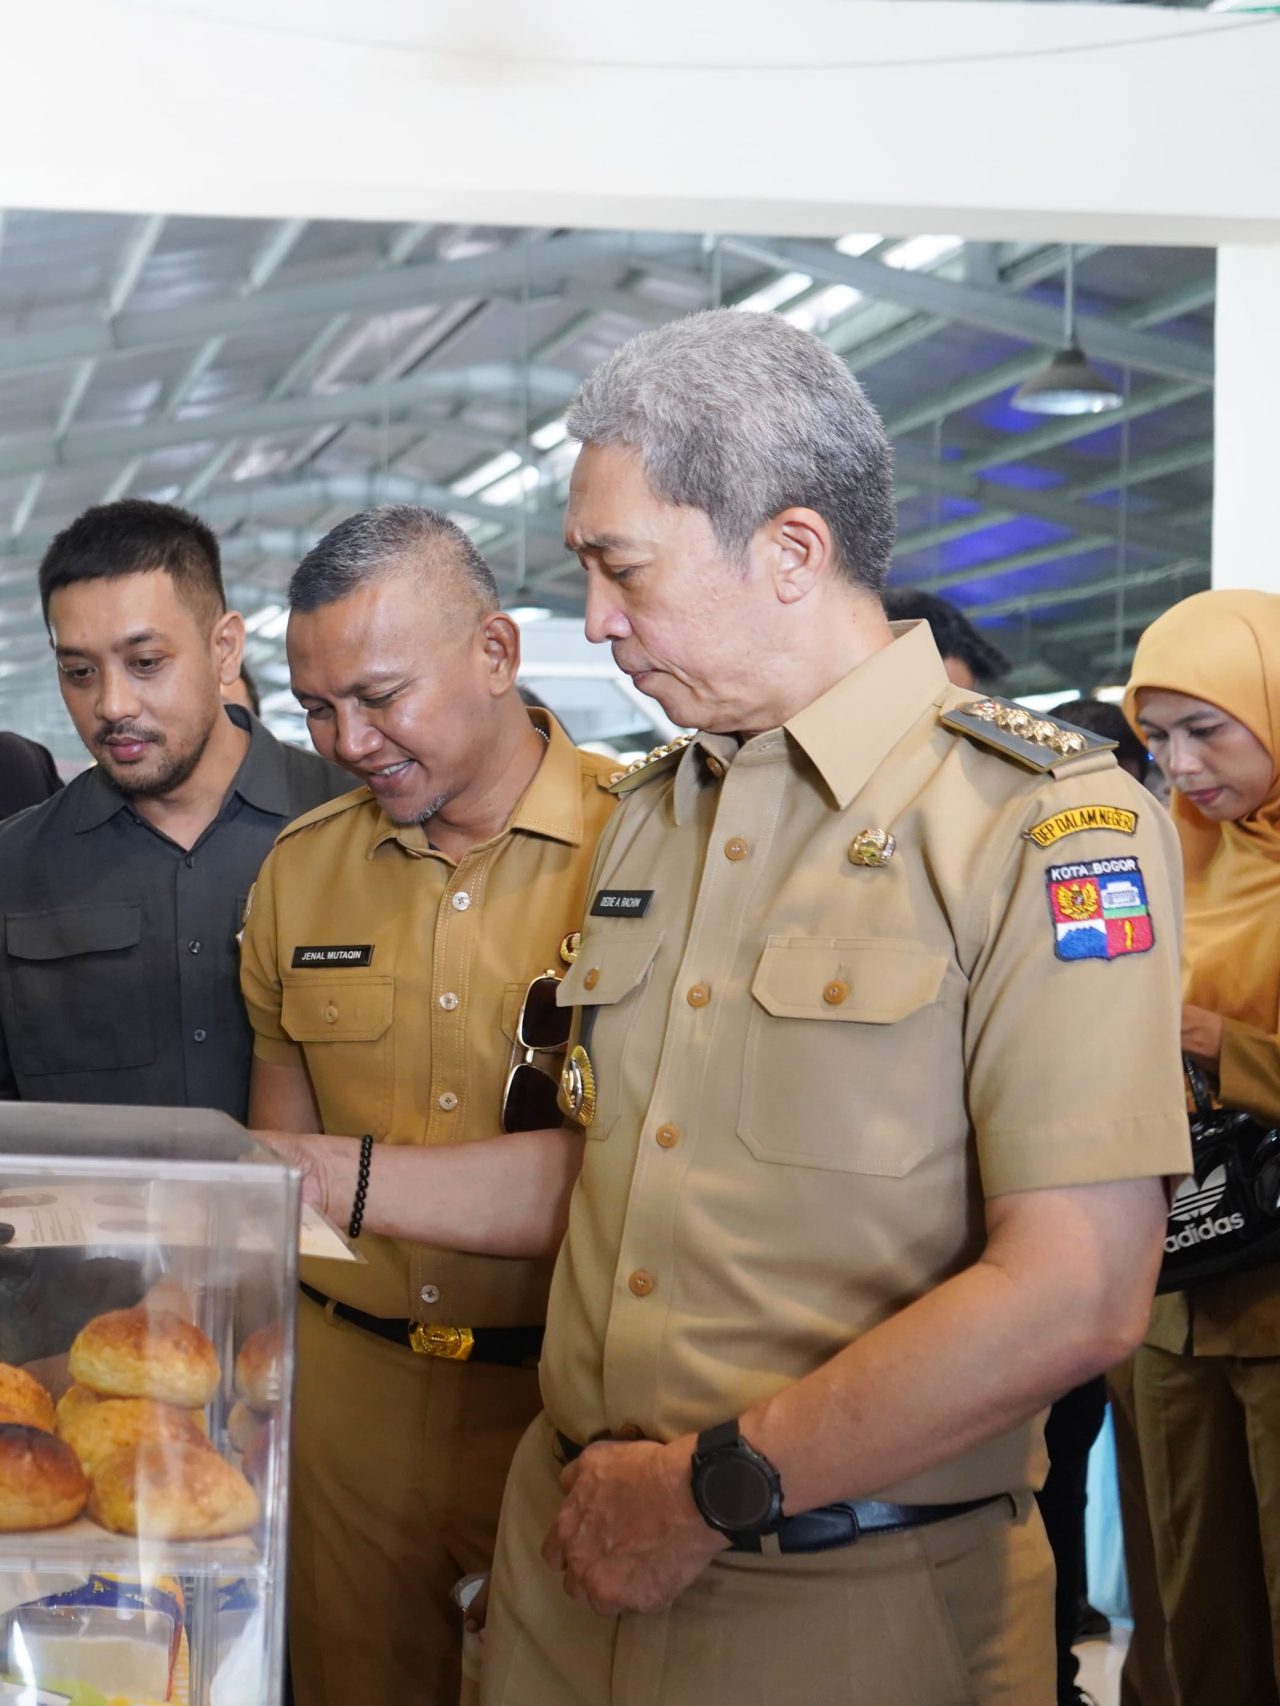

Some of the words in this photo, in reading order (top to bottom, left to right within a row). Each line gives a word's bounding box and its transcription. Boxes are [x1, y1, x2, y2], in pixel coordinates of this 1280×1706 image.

[1033, 824, 1056, 843] DEP
[1055, 809, 1097, 833] DALAM
[1051, 865, 1089, 881] KOTA
[1092, 859, 1137, 875] BOGOR
[301, 951, 326, 961] JENAL
[326, 950, 362, 960] MUTAQIN
[1164, 1212, 1245, 1253] adidas
